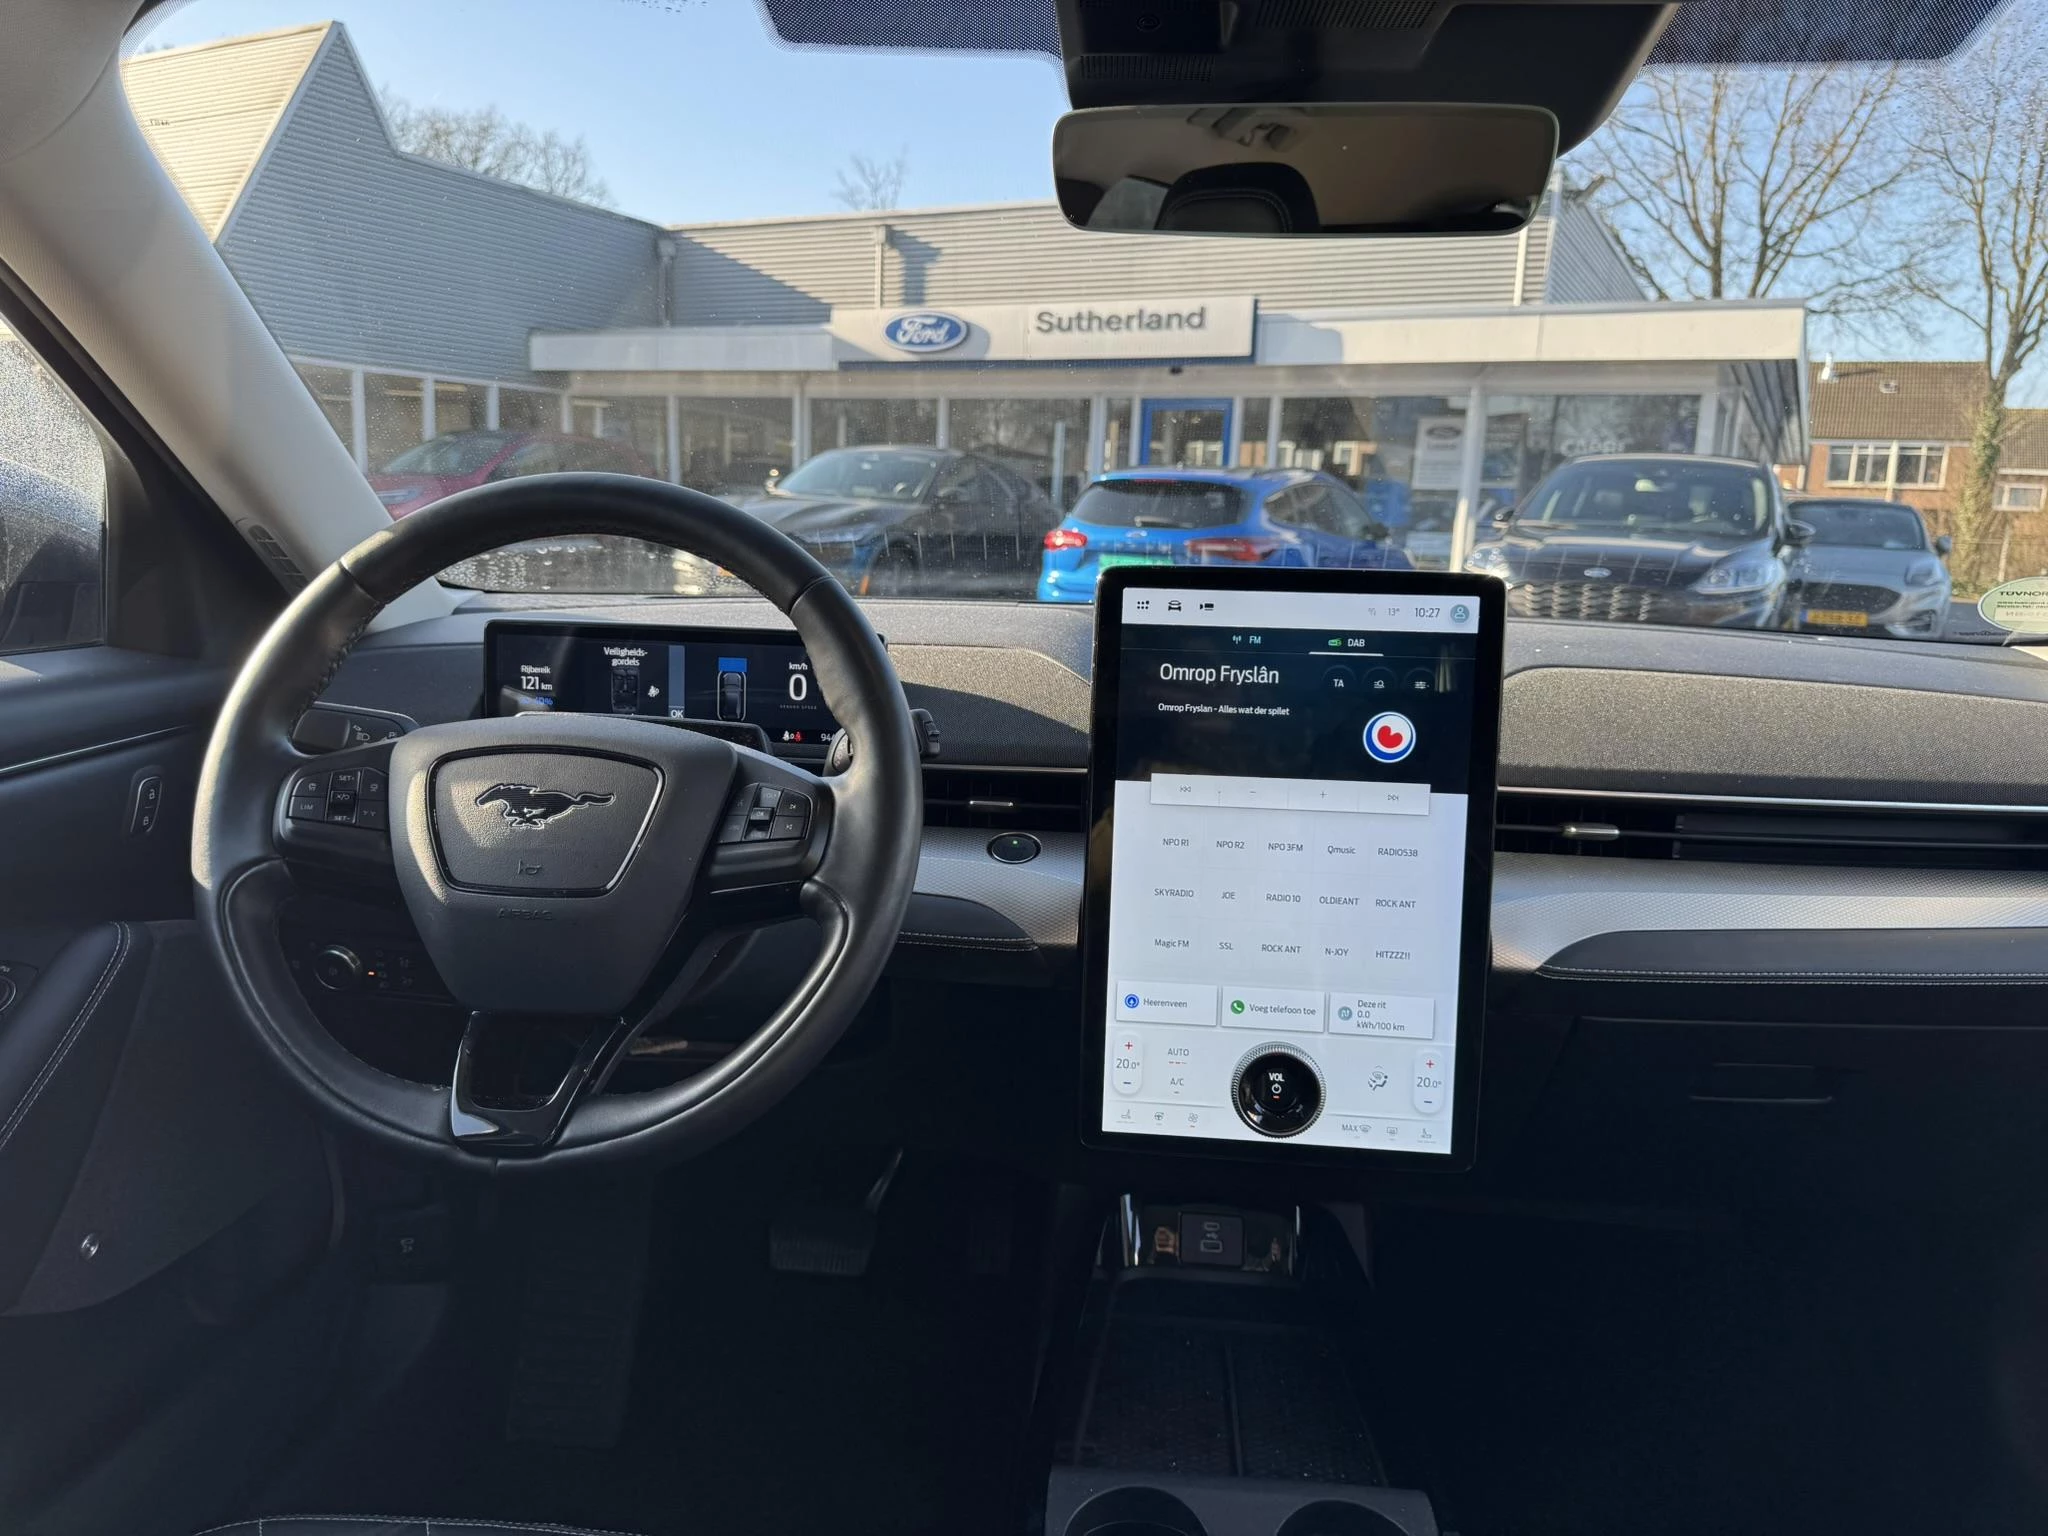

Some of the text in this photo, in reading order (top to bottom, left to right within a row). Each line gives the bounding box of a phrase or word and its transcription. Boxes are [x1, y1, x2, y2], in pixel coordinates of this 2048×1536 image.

[1036, 306, 1205, 334] Sutherland
[895, 316, 952, 345] Ford
[1414, 607, 1440, 618] 10:27
[1249, 635, 1261, 644] FM
[1347, 638, 1366, 648] DAB
[611, 657, 640, 667] gordels
[788, 662, 808, 671] km/h
[520, 665, 551, 674] Rijbereik
[1160, 663, 1279, 685] Omrop Fryslân
[520, 676, 552, 690] 121 km
[789, 673, 807, 701] 0
[1333, 679, 1344, 688] TA
[670, 710, 684, 718] OK
[1158, 703, 1184, 713] Omrop
[1185, 704, 1212, 714] Fryslan
[1218, 705, 1237, 714] Alles
[1254, 706, 1267, 715] der
[1163, 838, 1189, 847] NPO R1
[1216, 840, 1245, 850] NPO R2
[1268, 843, 1303, 852] NPO 3FM
[1327, 845, 1356, 855] Qmusic
[1377, 848, 1418, 857] RADIO538
[1154, 888, 1194, 898] SKYRADIO
[1221, 891, 1236, 900] JOE
[1266, 894, 1291, 902] RADIO
[1319, 896, 1359, 906] OLDIEANT
[1375, 899, 1416, 909] ROCK ANT
[1154, 939, 1190, 949] Magic FM
[1219, 942, 1234, 950] SSL
[1261, 944, 1302, 954] ROCK ANT
[1325, 948, 1349, 957] N-JOY
[1143, 998, 1188, 1008] Heerenveen
[1357, 1000, 1387, 1009] Deze rit
[1249, 1003, 1316, 1015] Voeg telefoon toe
[1357, 1010, 1371, 1019] 0.0
[1356, 1021, 1405, 1031] kWh/100 km
[1167, 1048, 1190, 1057] AUTO
[1170, 1078, 1185, 1087] A/C
[1269, 1073, 1285, 1082] VOL
[1341, 1123, 1358, 1132] MAX
